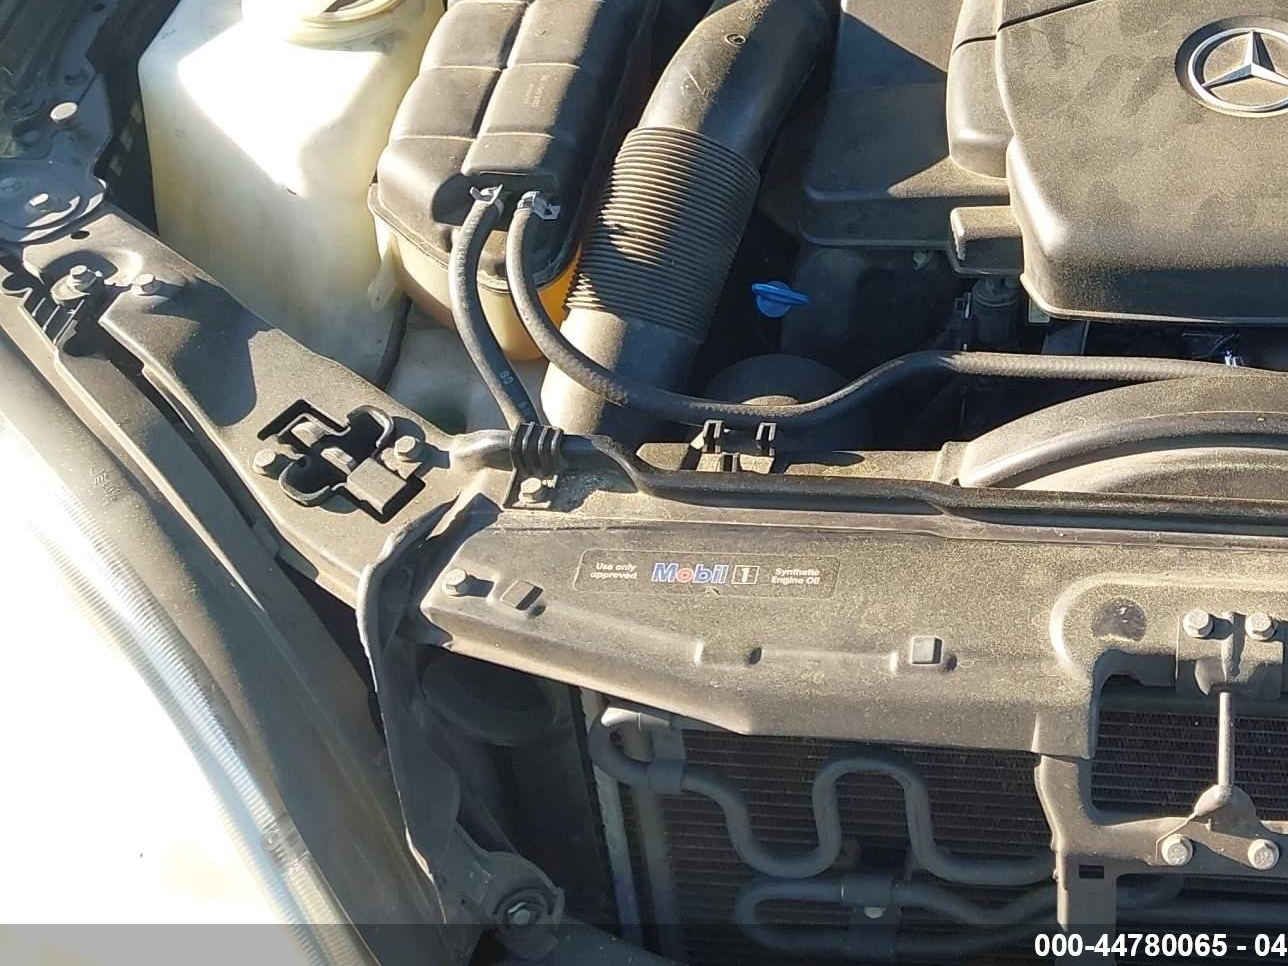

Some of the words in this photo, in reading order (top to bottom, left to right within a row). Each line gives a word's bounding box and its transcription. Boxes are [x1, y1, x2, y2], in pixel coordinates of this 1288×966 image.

[595, 562, 613, 571] Use
[614, 563, 637, 573] only
[774, 567, 820, 577] Synthetic
[590, 571, 638, 580] approved
[650, 562, 729, 584] Mobil
[771, 575, 805, 585] Engine
[805, 576, 821, 585] Oil
